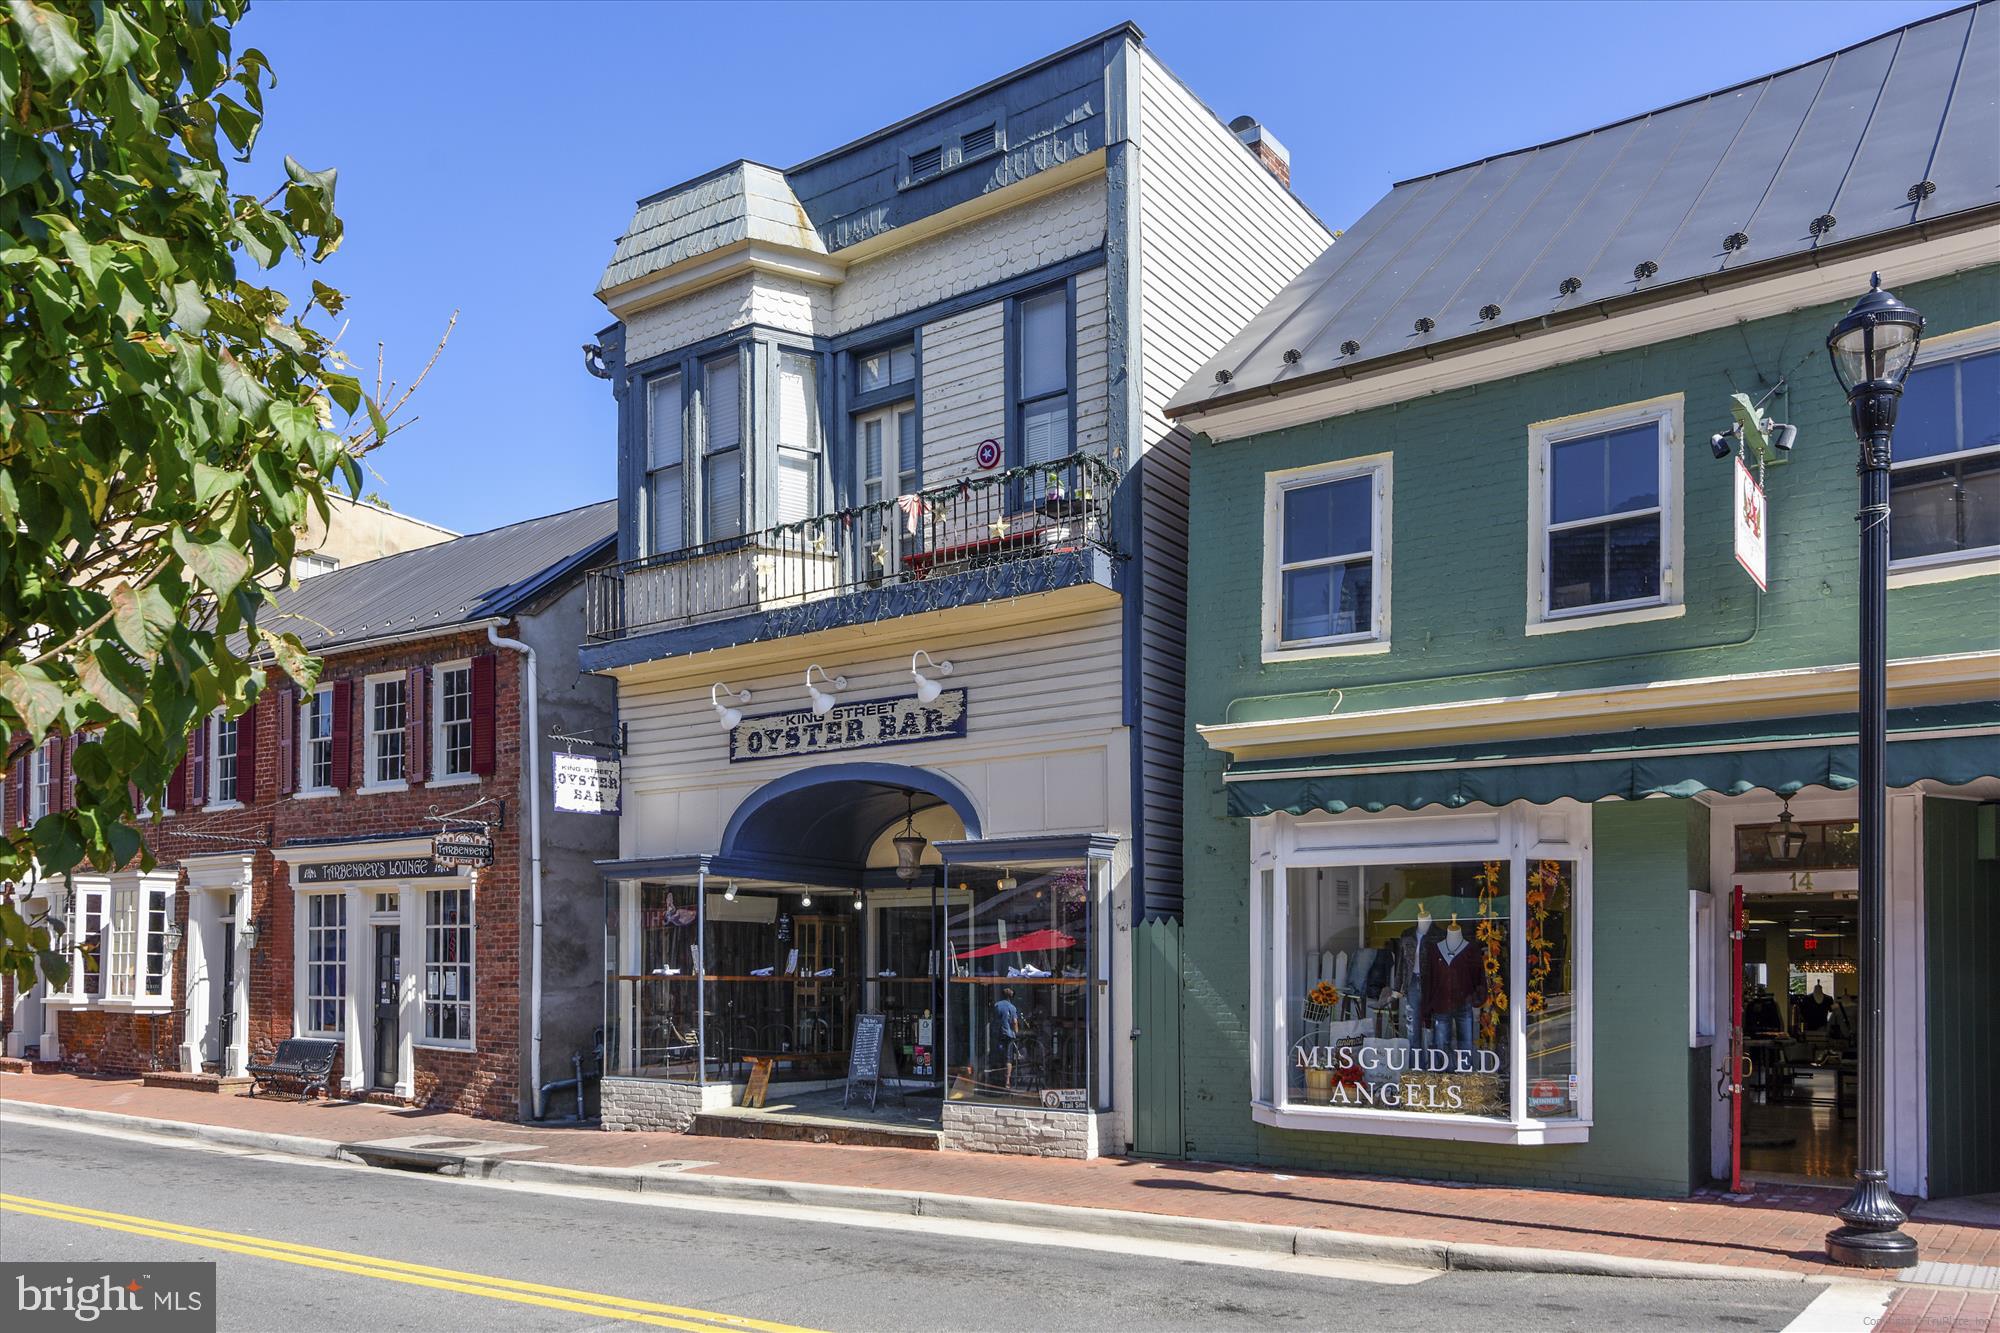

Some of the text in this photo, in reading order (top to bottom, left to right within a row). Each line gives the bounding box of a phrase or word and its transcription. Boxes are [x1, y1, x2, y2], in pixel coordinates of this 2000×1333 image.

[786, 702, 899, 726] KING STREET
[747, 708, 949, 753] OYSTER BAR
[558, 773, 618, 789] OYSTER
[574, 789, 604, 802] BAR
[321, 859, 429, 880] TARBENDER'S LOUNGE
[1789, 872, 1814, 891] 14
[1296, 1046, 1500, 1073] MISGUIDED
[1062, 1101, 1073, 1109] Trail
[1330, 1080, 1462, 1109] ANGELS
